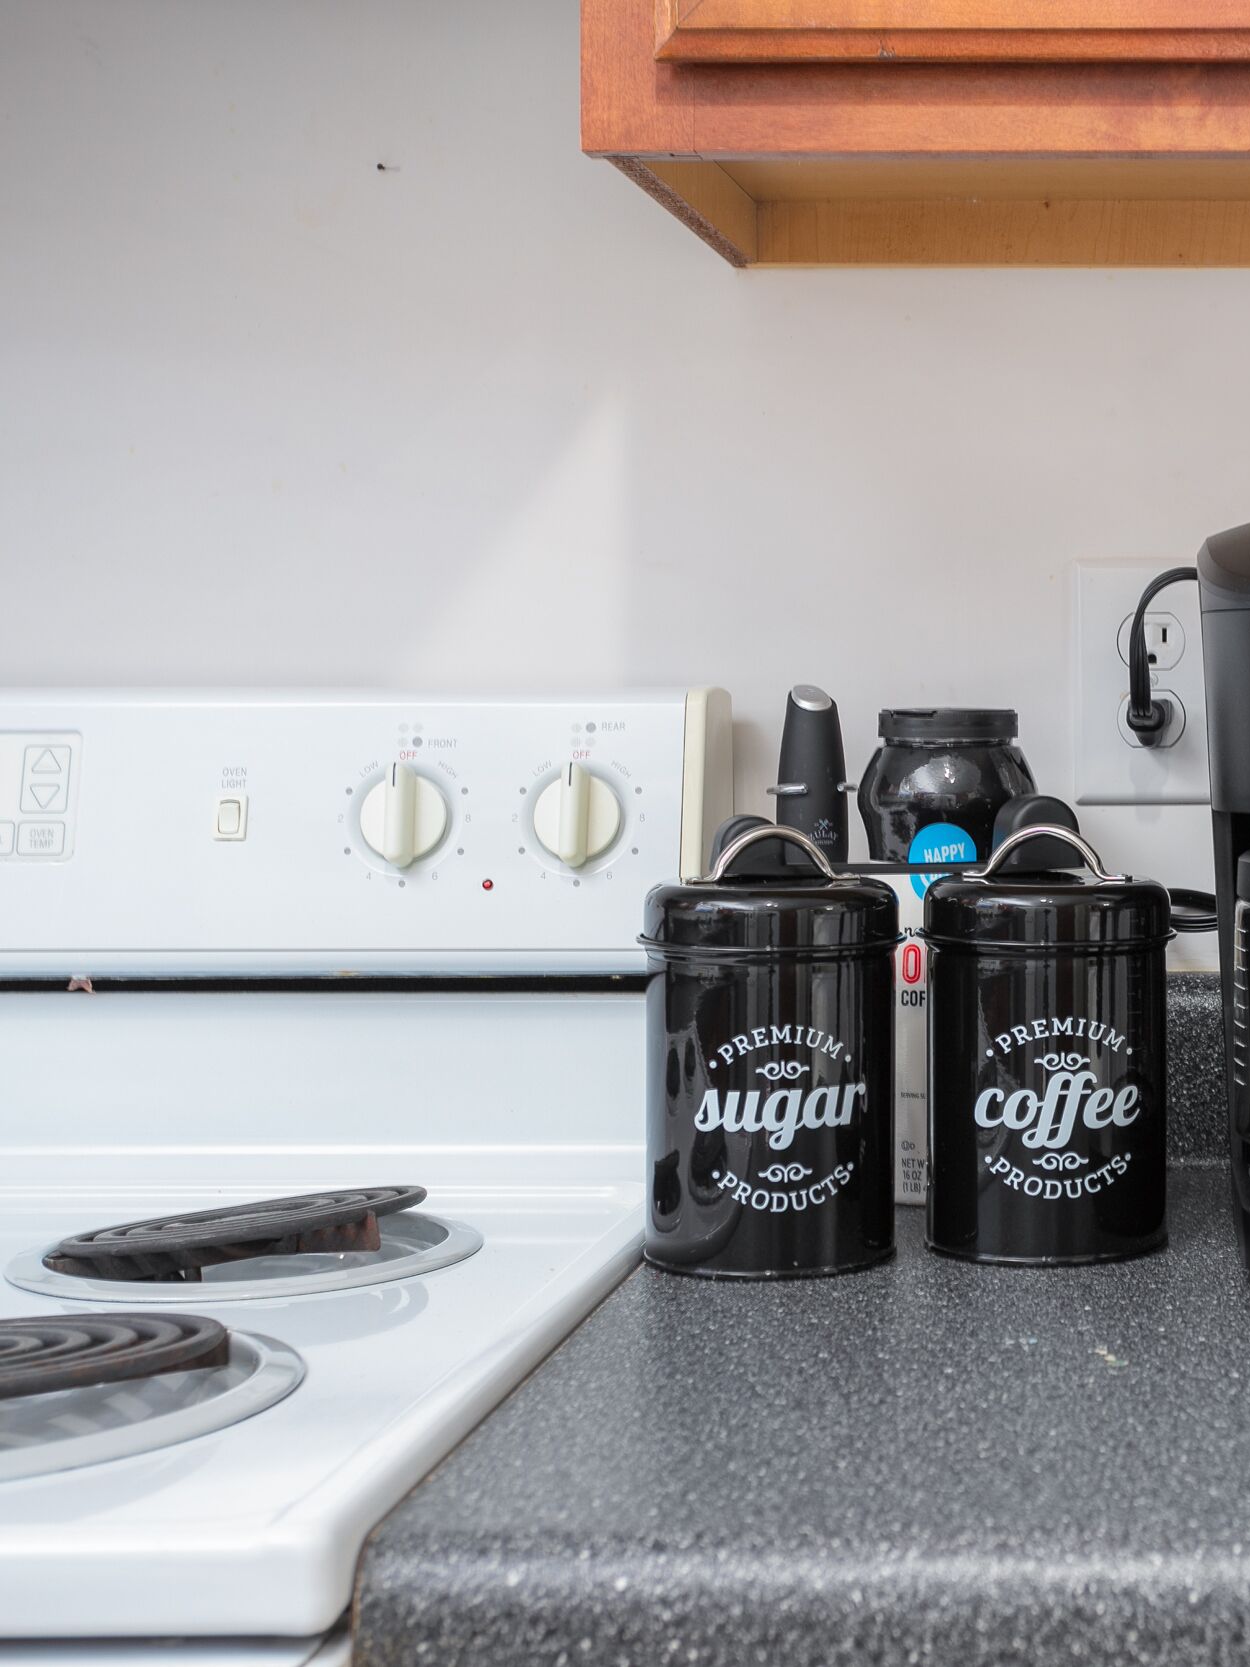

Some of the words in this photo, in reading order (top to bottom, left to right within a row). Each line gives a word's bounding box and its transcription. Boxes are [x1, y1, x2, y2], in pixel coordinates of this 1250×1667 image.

[601, 722, 626, 731] REAR
[428, 739, 457, 748] FRONT
[399, 751, 417, 760] OFF
[572, 751, 591, 760] OFF
[222, 767, 247, 777] OVEN
[359, 760, 380, 778] LOW
[438, 760, 458, 779] HIGH
[533, 760, 552, 777] LOW
[611, 760, 632, 778] HIGH
[221, 779, 247, 789] LIGHT
[337, 814, 344, 823] 2
[465, 814, 471, 823] 8
[511, 814, 518, 822] 2
[639, 814, 646, 822] 8
[923, 842, 965, 863] HAPPY
[901, 989, 926, 1007] COF
[995, 1017, 1125, 1054] PREMIUM
[717, 1024, 844, 1065] PREMIUM
[694, 1082, 866, 1150] sugar
[974, 1071, 1140, 1149] coffee
[902, 1158, 915, 1168] NET
[917, 1159, 925, 1169] W
[903, 1170, 910, 1180] 16
[912, 1170, 922, 1181] OZ
[990, 1154, 1127, 1199] PRODUCTS
[717, 1165, 850, 1212] PRODUCTS
